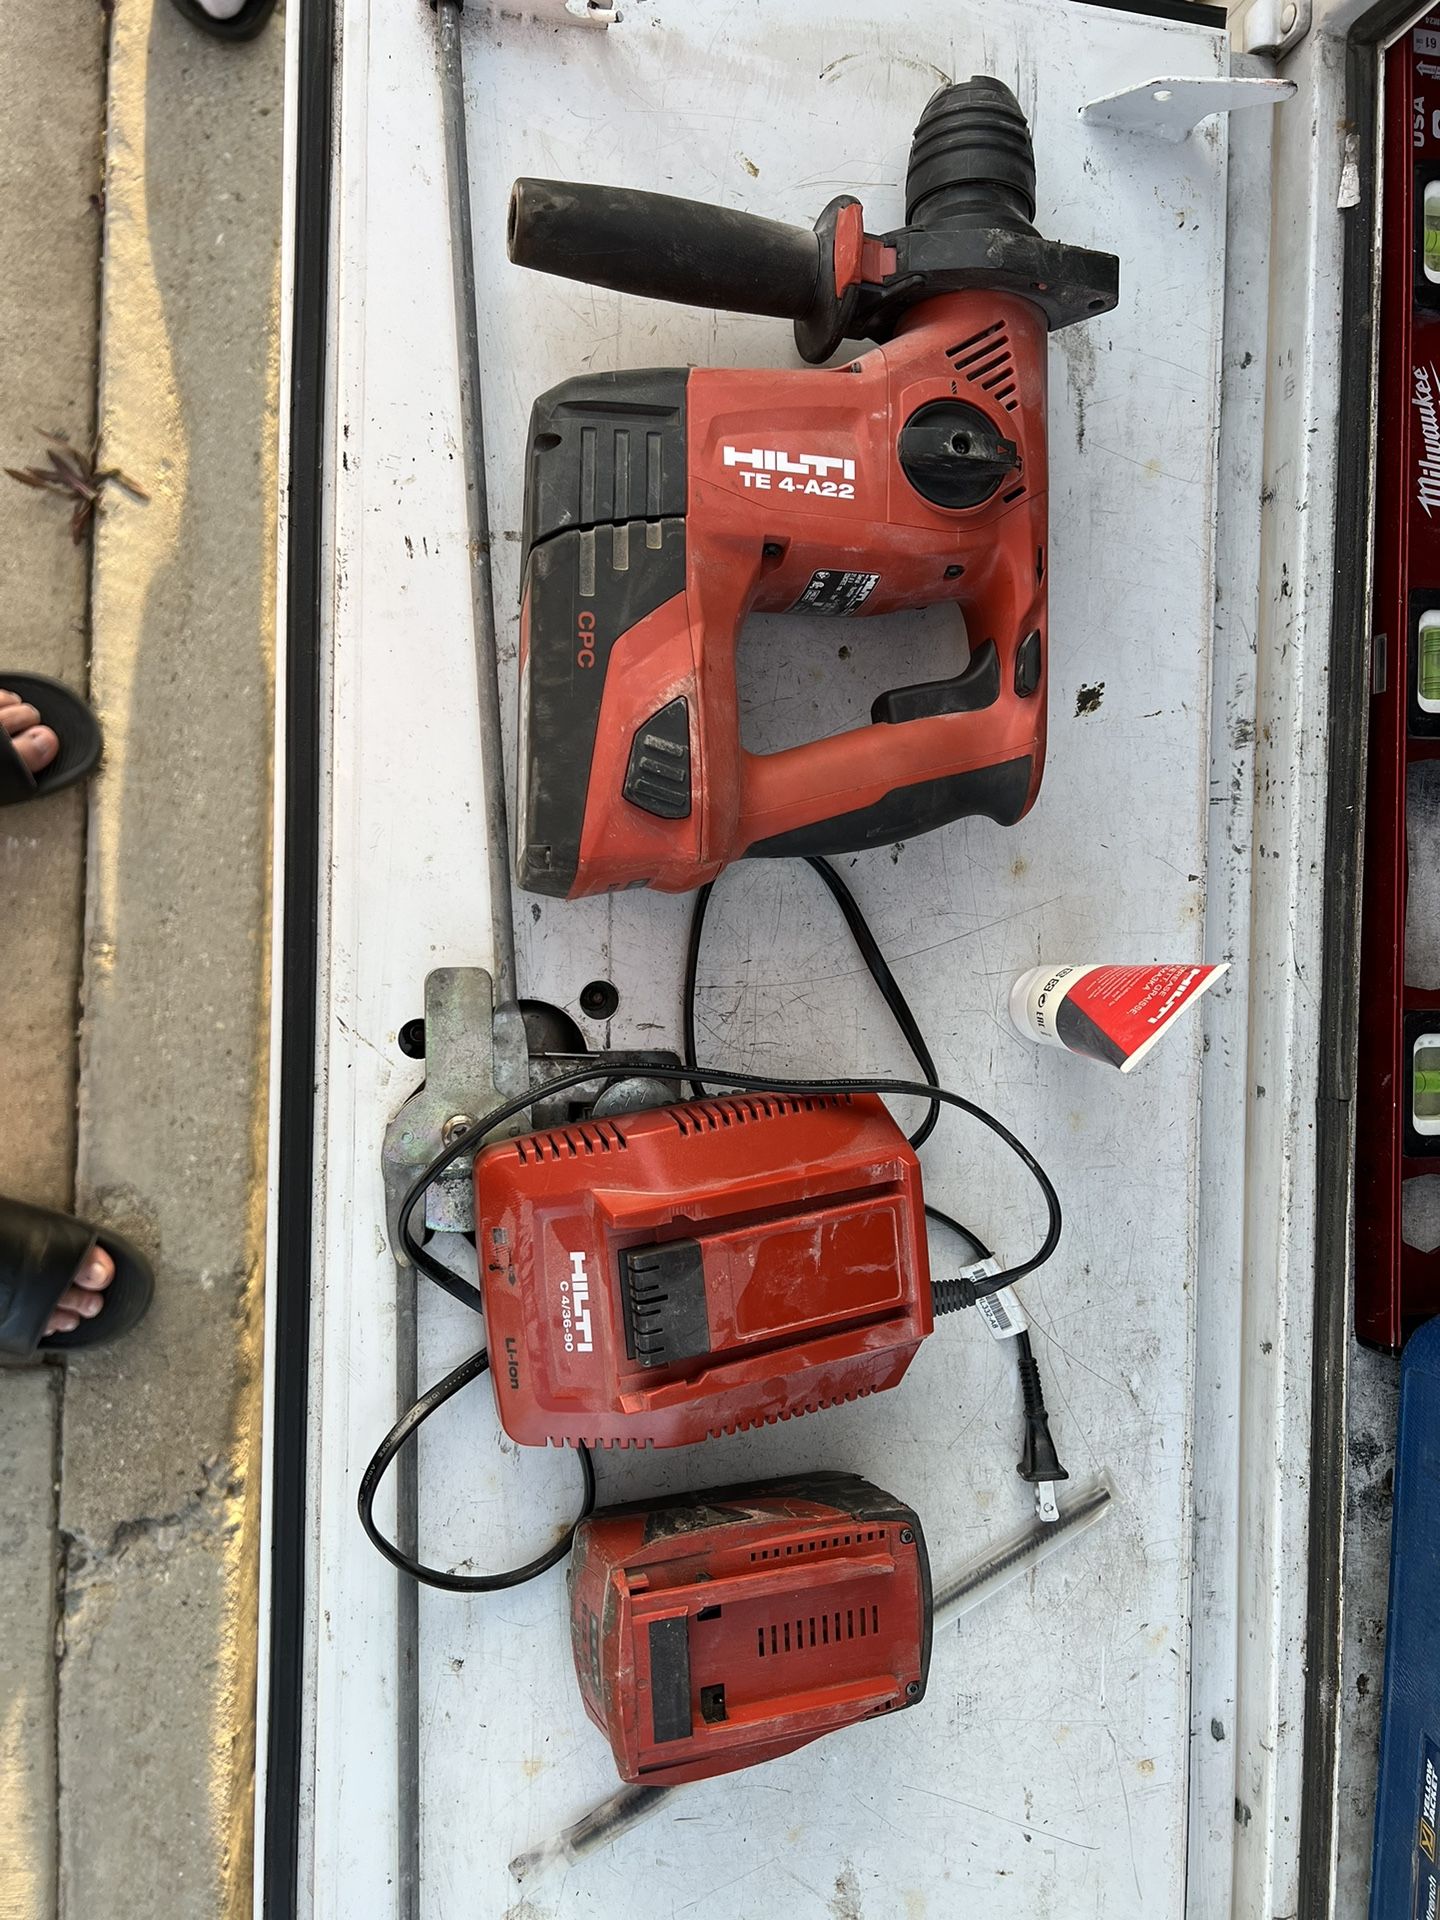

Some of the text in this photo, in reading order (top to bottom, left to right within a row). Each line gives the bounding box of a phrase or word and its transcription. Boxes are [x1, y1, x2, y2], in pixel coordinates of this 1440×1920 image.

[1413, 96, 1425, 148] USA
[724, 446, 855, 480] HILTI
[1411, 366, 1440, 518] Milwaukee
[740, 471, 855, 499] TE 4-A22
[578, 611, 596, 669] CPC
[1147, 968, 1201, 1024] HILTI
[560, 1281, 574, 1352] C 4/36-90
[570, 1251, 593, 1352] HILTI
[1423, 1758, 1433, 1818] YELLOW
[1429, 1768, 1438, 1828] JACKET
